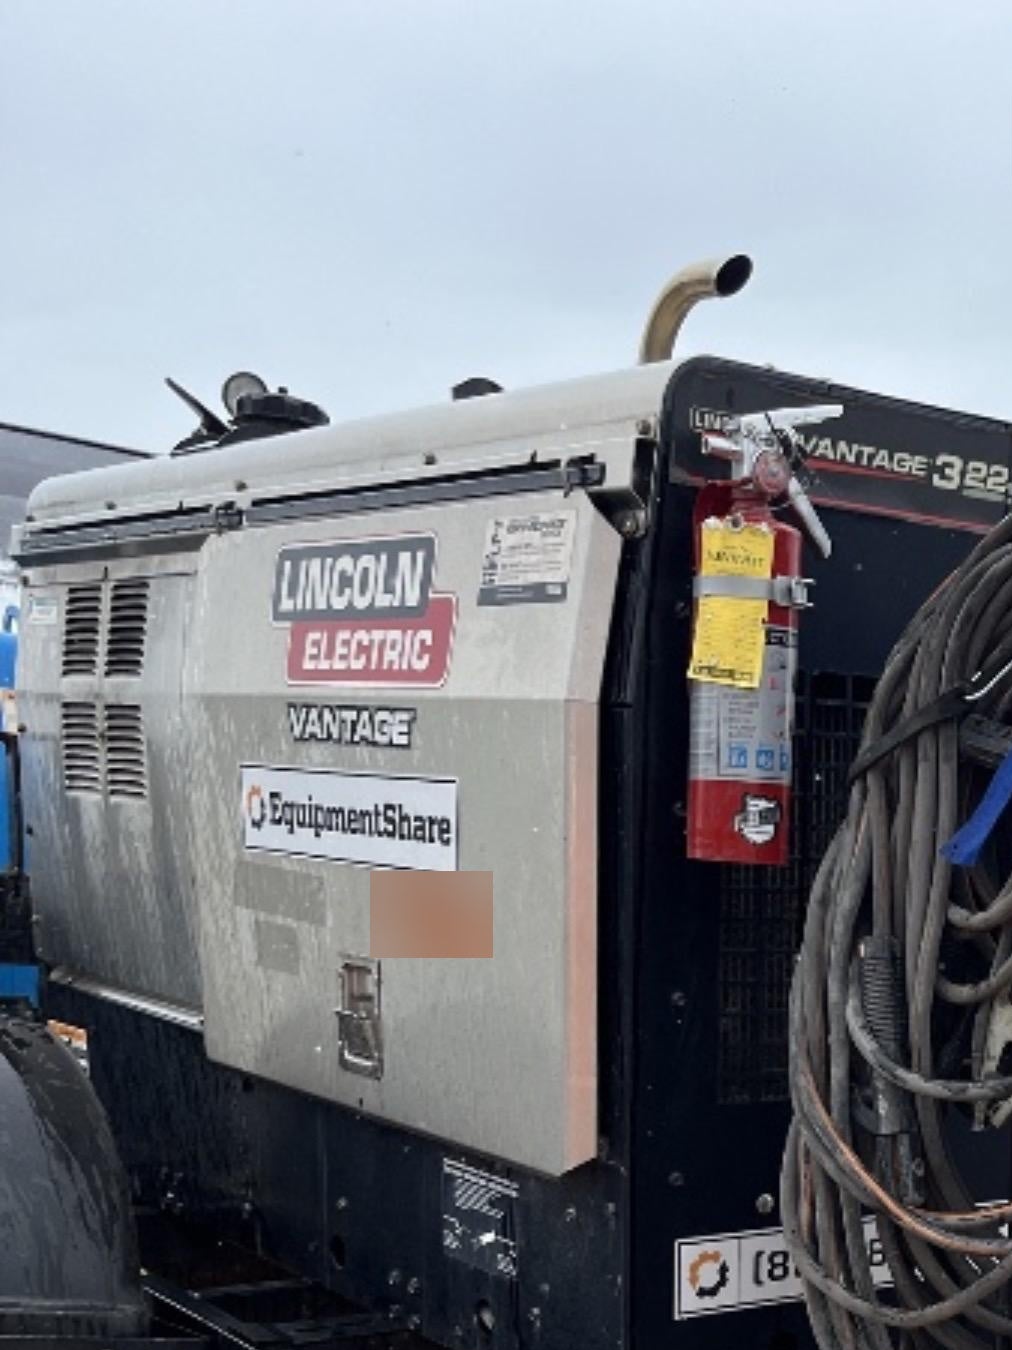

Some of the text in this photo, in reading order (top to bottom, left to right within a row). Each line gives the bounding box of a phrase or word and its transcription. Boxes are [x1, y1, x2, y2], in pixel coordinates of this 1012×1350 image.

[797, 432, 927, 476] VANTAGE
[932, 453, 1009, 494] 322
[279, 551, 426, 613] LINCOLN
[302, 629, 433, 671] ELECTRIC
[288, 705, 413, 747] VANTAGE
[269, 791, 451, 847] EquipmentShare
